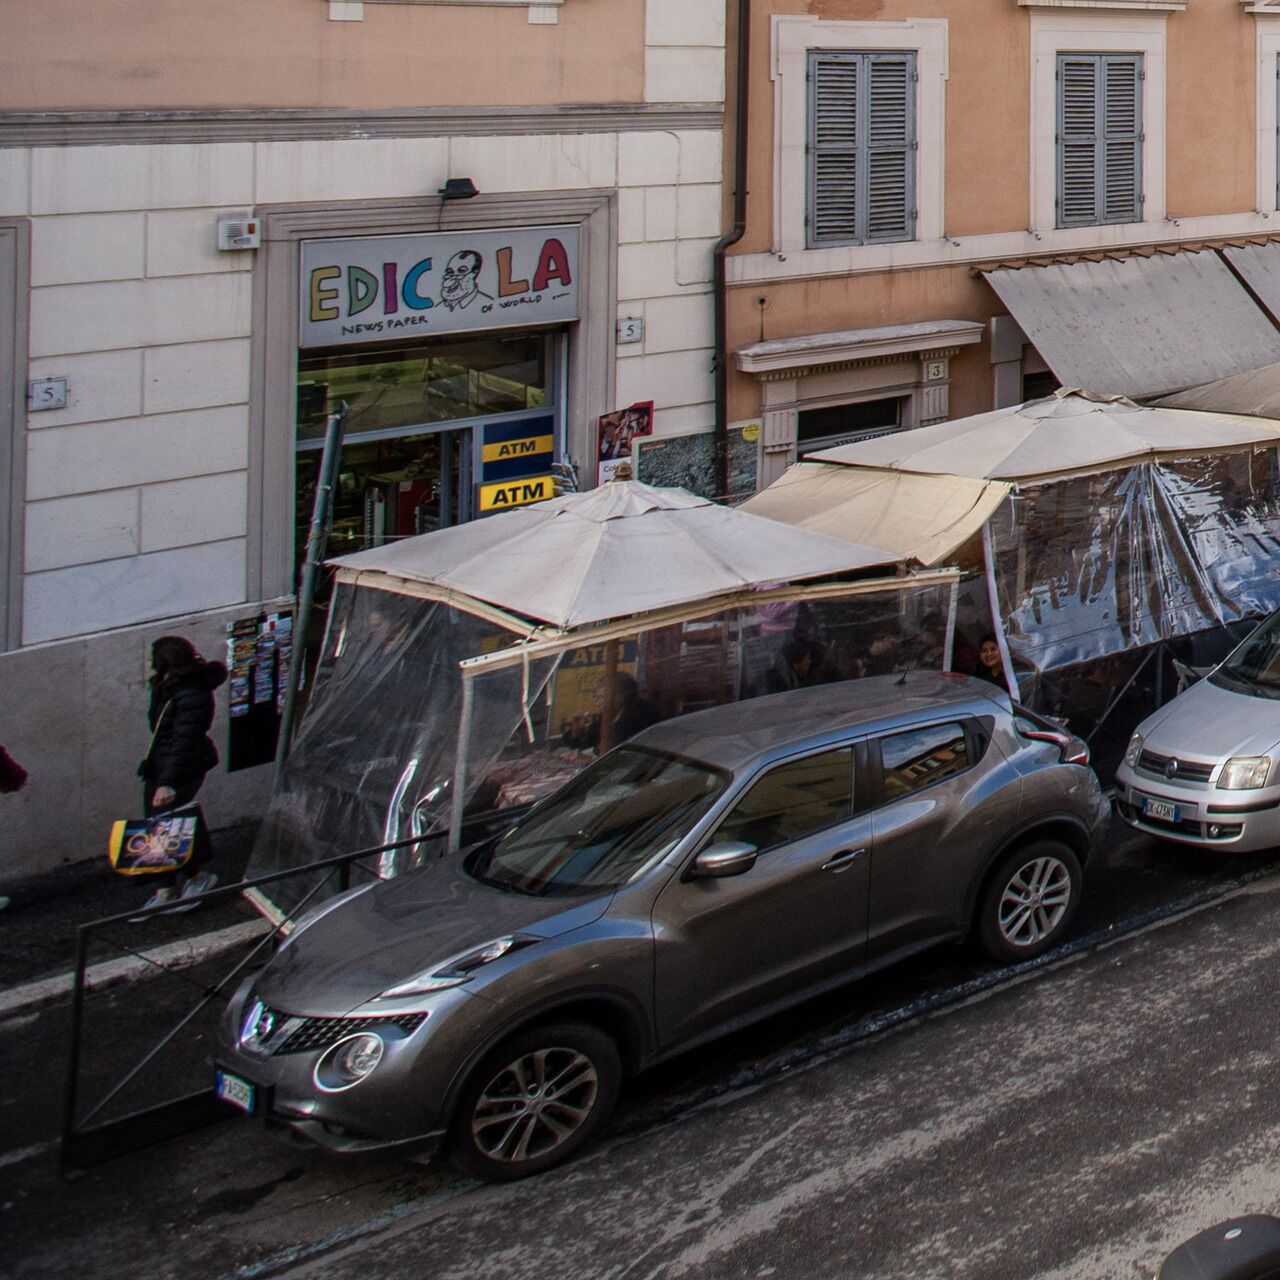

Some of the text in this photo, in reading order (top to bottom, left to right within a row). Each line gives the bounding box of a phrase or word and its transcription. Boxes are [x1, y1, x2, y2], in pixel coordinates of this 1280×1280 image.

[481, 294, 542, 314] OF WORLD
[626, 323, 635, 338] 5
[932, 365, 941, 377] 3
[498, 440, 537, 458] ATM
[492, 481, 545, 506] ATM
